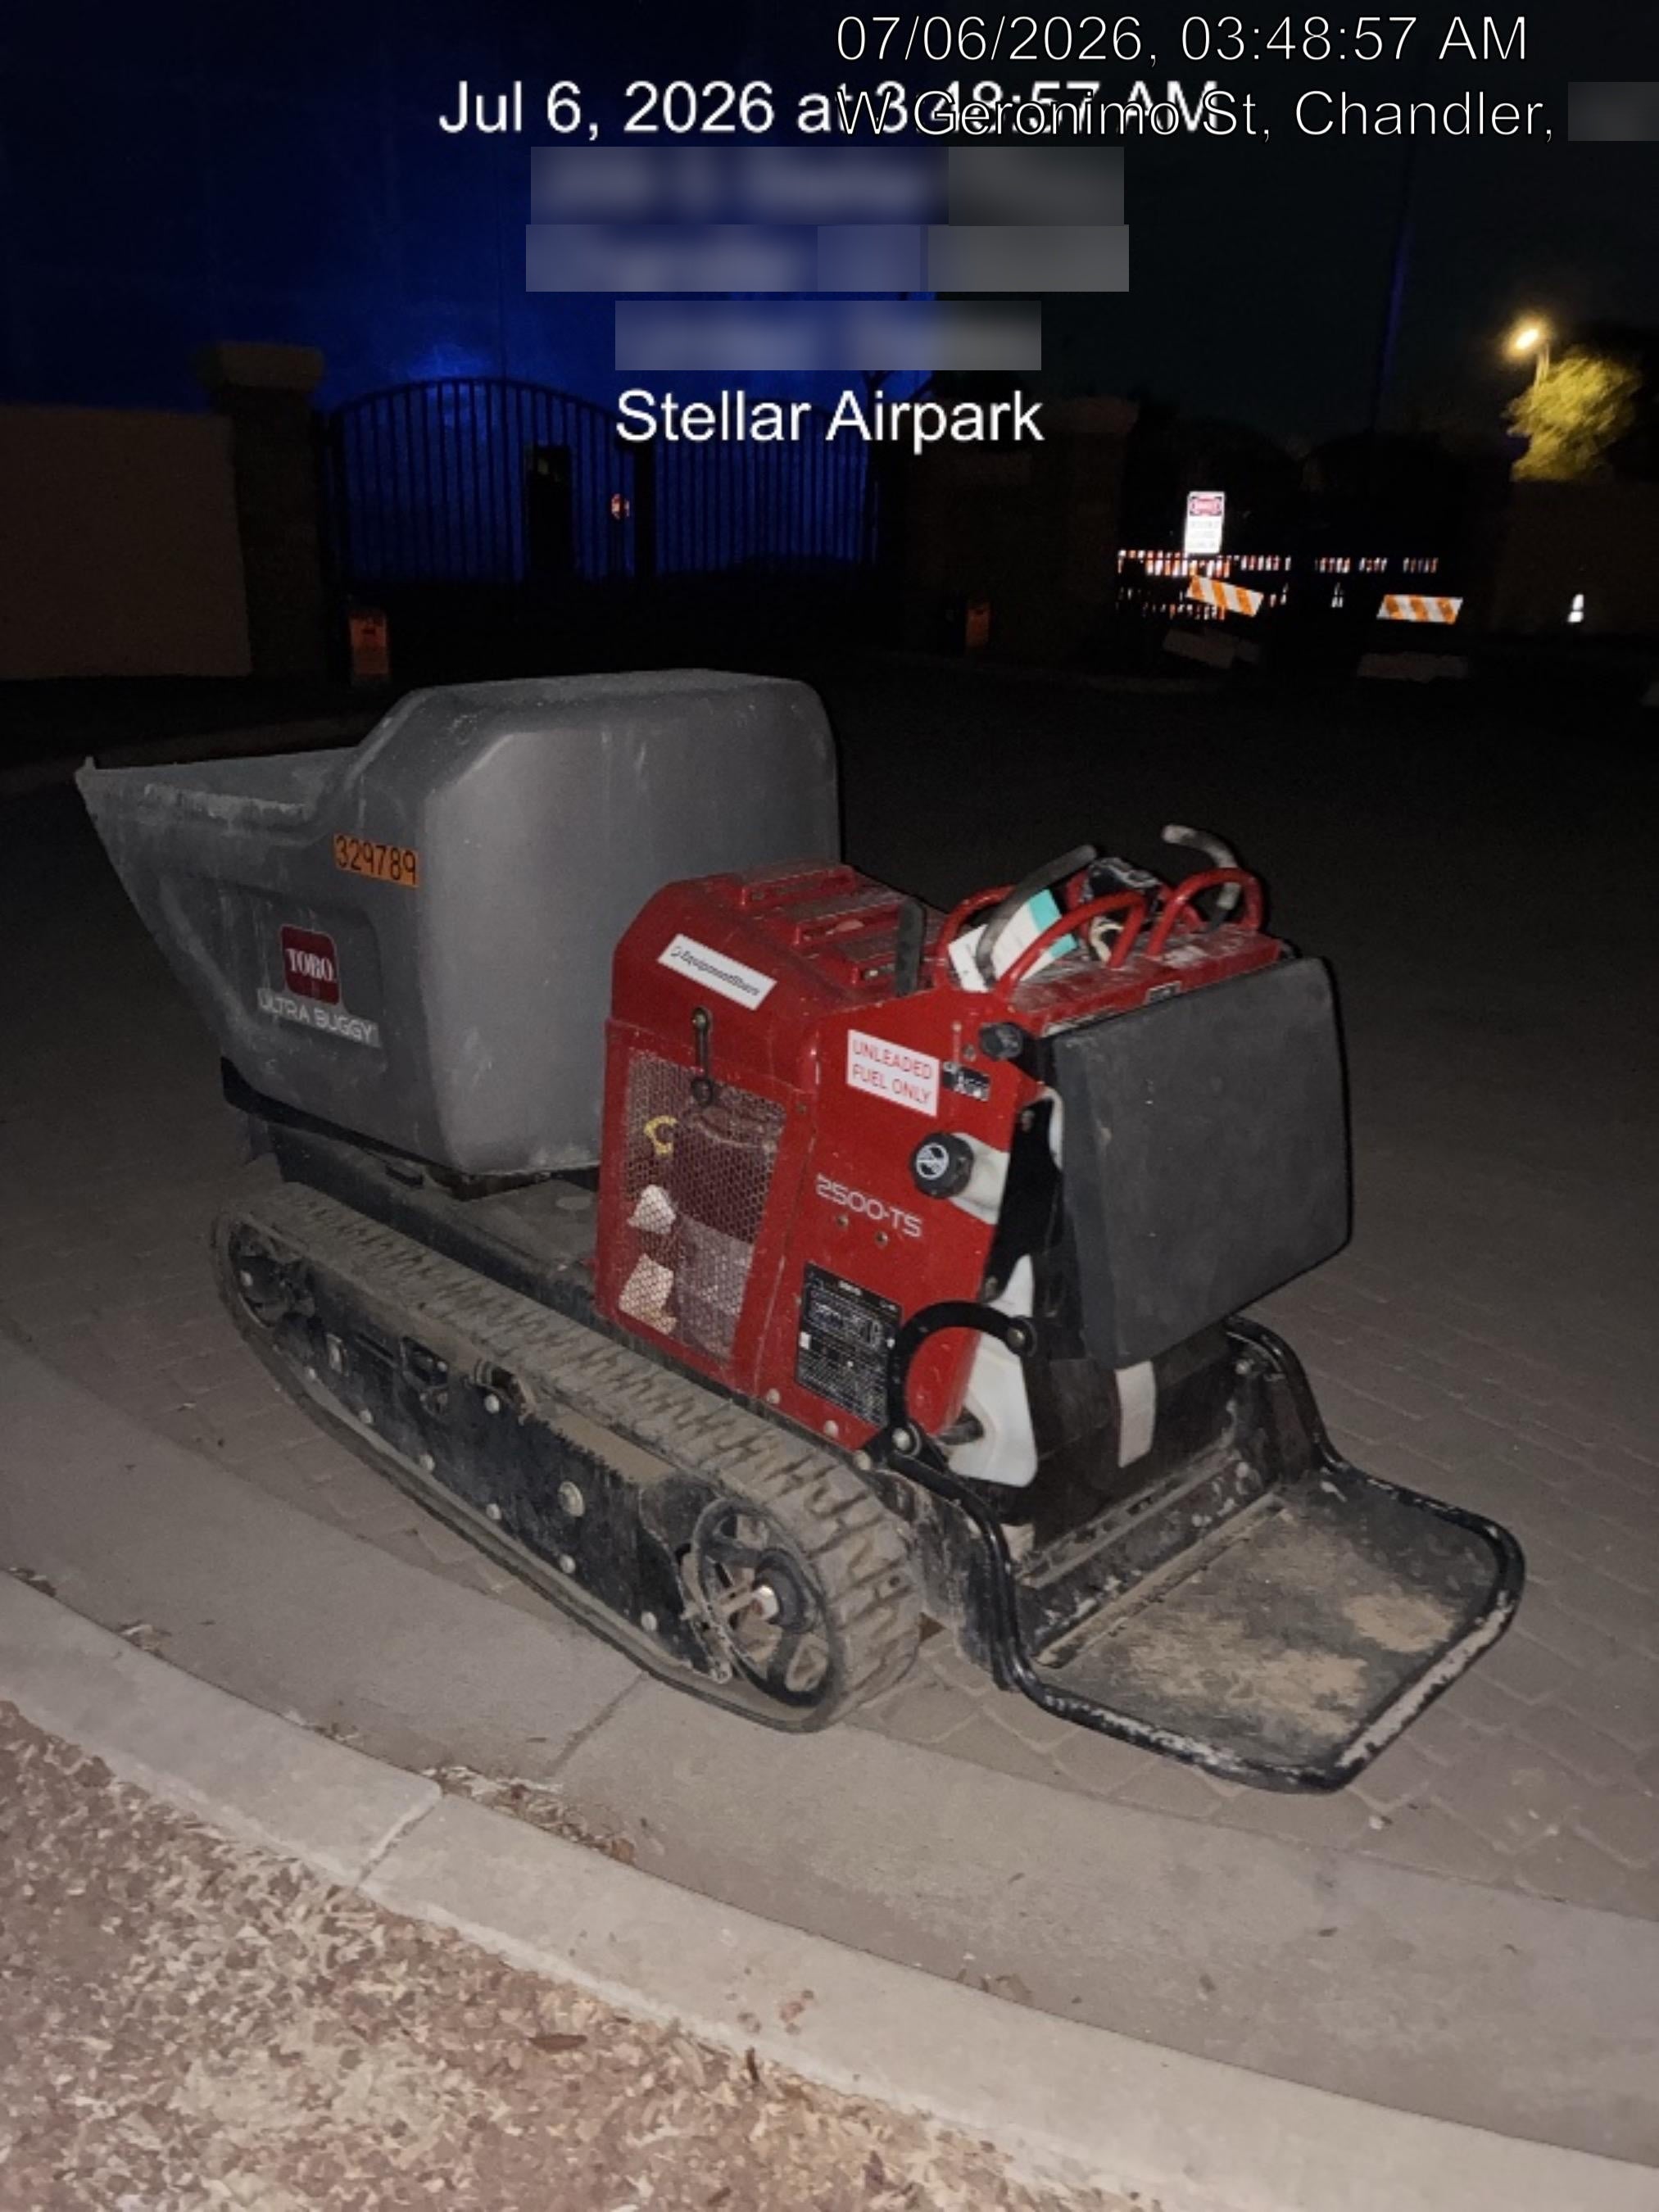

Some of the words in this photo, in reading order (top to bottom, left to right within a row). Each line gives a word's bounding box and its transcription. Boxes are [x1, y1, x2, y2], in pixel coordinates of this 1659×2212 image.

[336, 833, 416, 885] 329789
[286, 948, 334, 981] TORO
[258, 988, 310, 1023] ULTRA
[314, 1007, 374, 1044] BUGGY
[852, 1038, 932, 1080] UNLEADED
[852, 1063, 887, 1090] FUEL
[892, 1077, 932, 1104] ONLY
